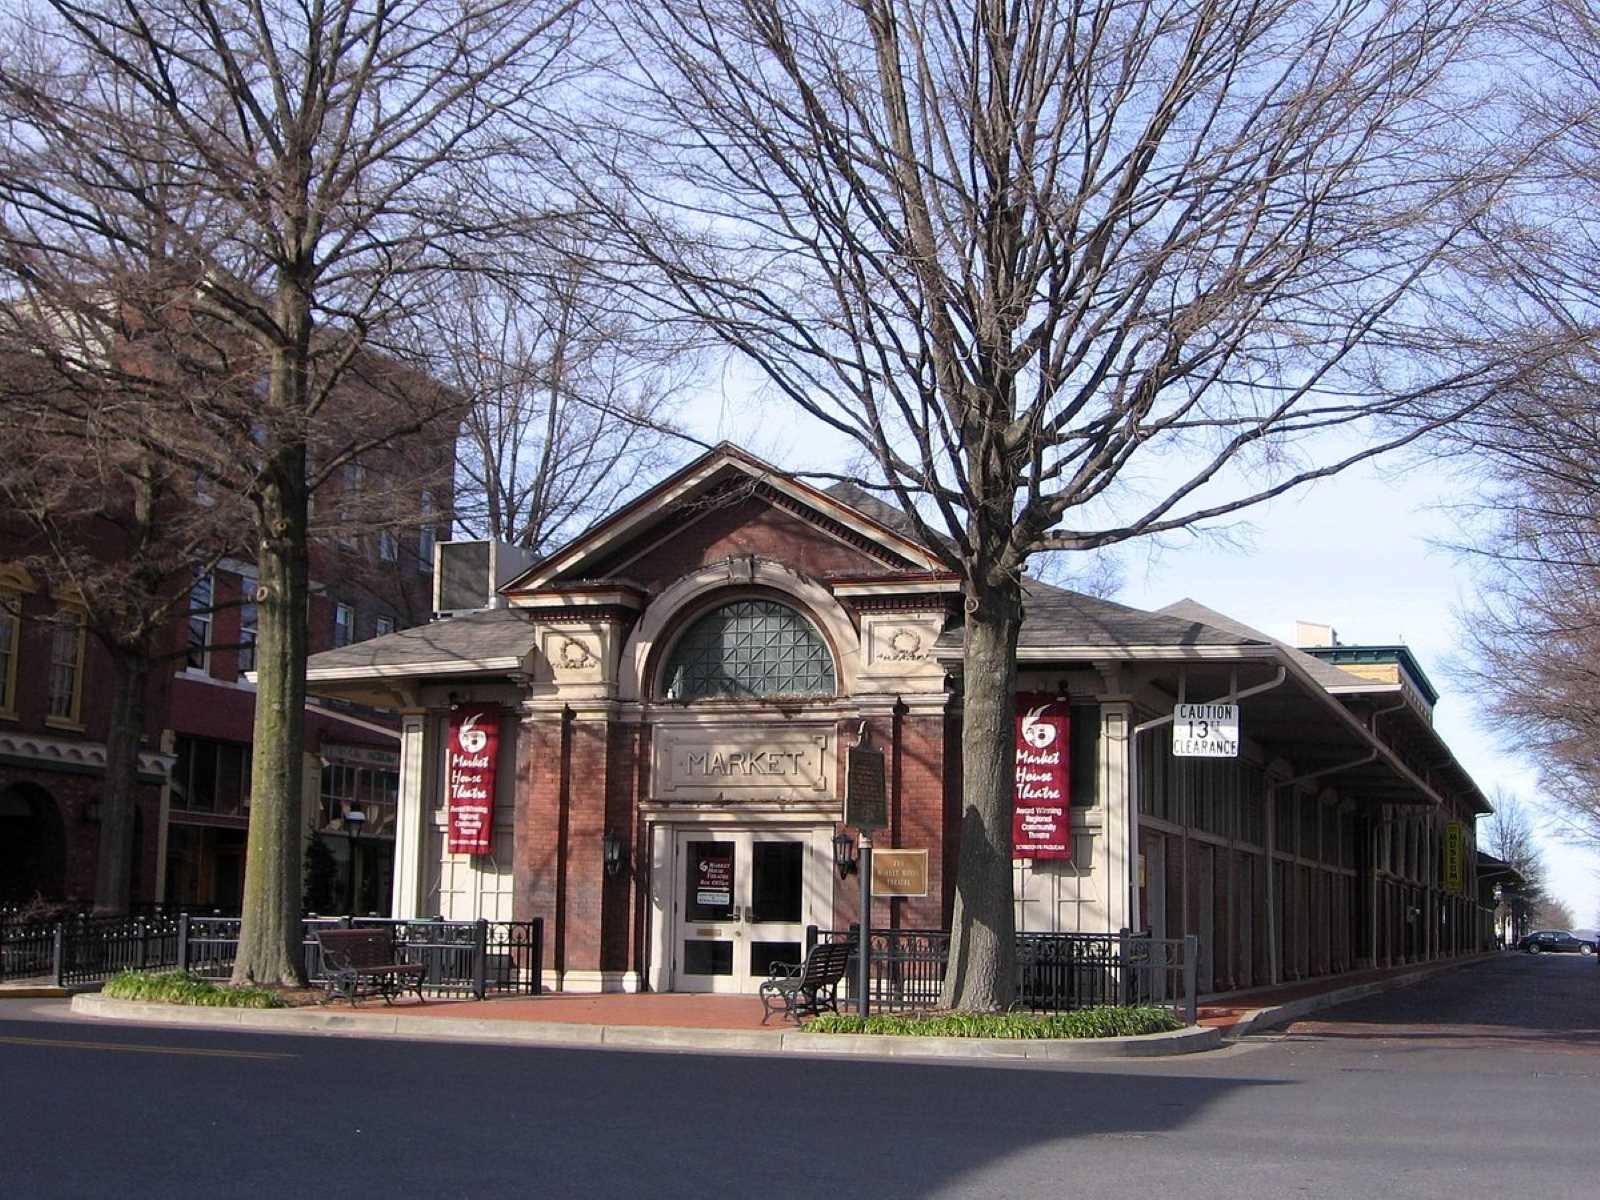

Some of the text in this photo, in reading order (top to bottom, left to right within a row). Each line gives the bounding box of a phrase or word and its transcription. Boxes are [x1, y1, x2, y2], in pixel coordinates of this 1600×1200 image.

[1180, 705, 1232, 719] CAUTION
[1174, 739, 1237, 754] CLEARANCE
[452, 753, 489, 768] Market
[687, 751, 804, 776] MARKET
[1015, 749, 1060, 764] Market
[452, 769, 482, 784] House
[1015, 765, 1053, 783] House
[451, 784, 488, 799] Theatre
[1016, 783, 1061, 799] Theatre
